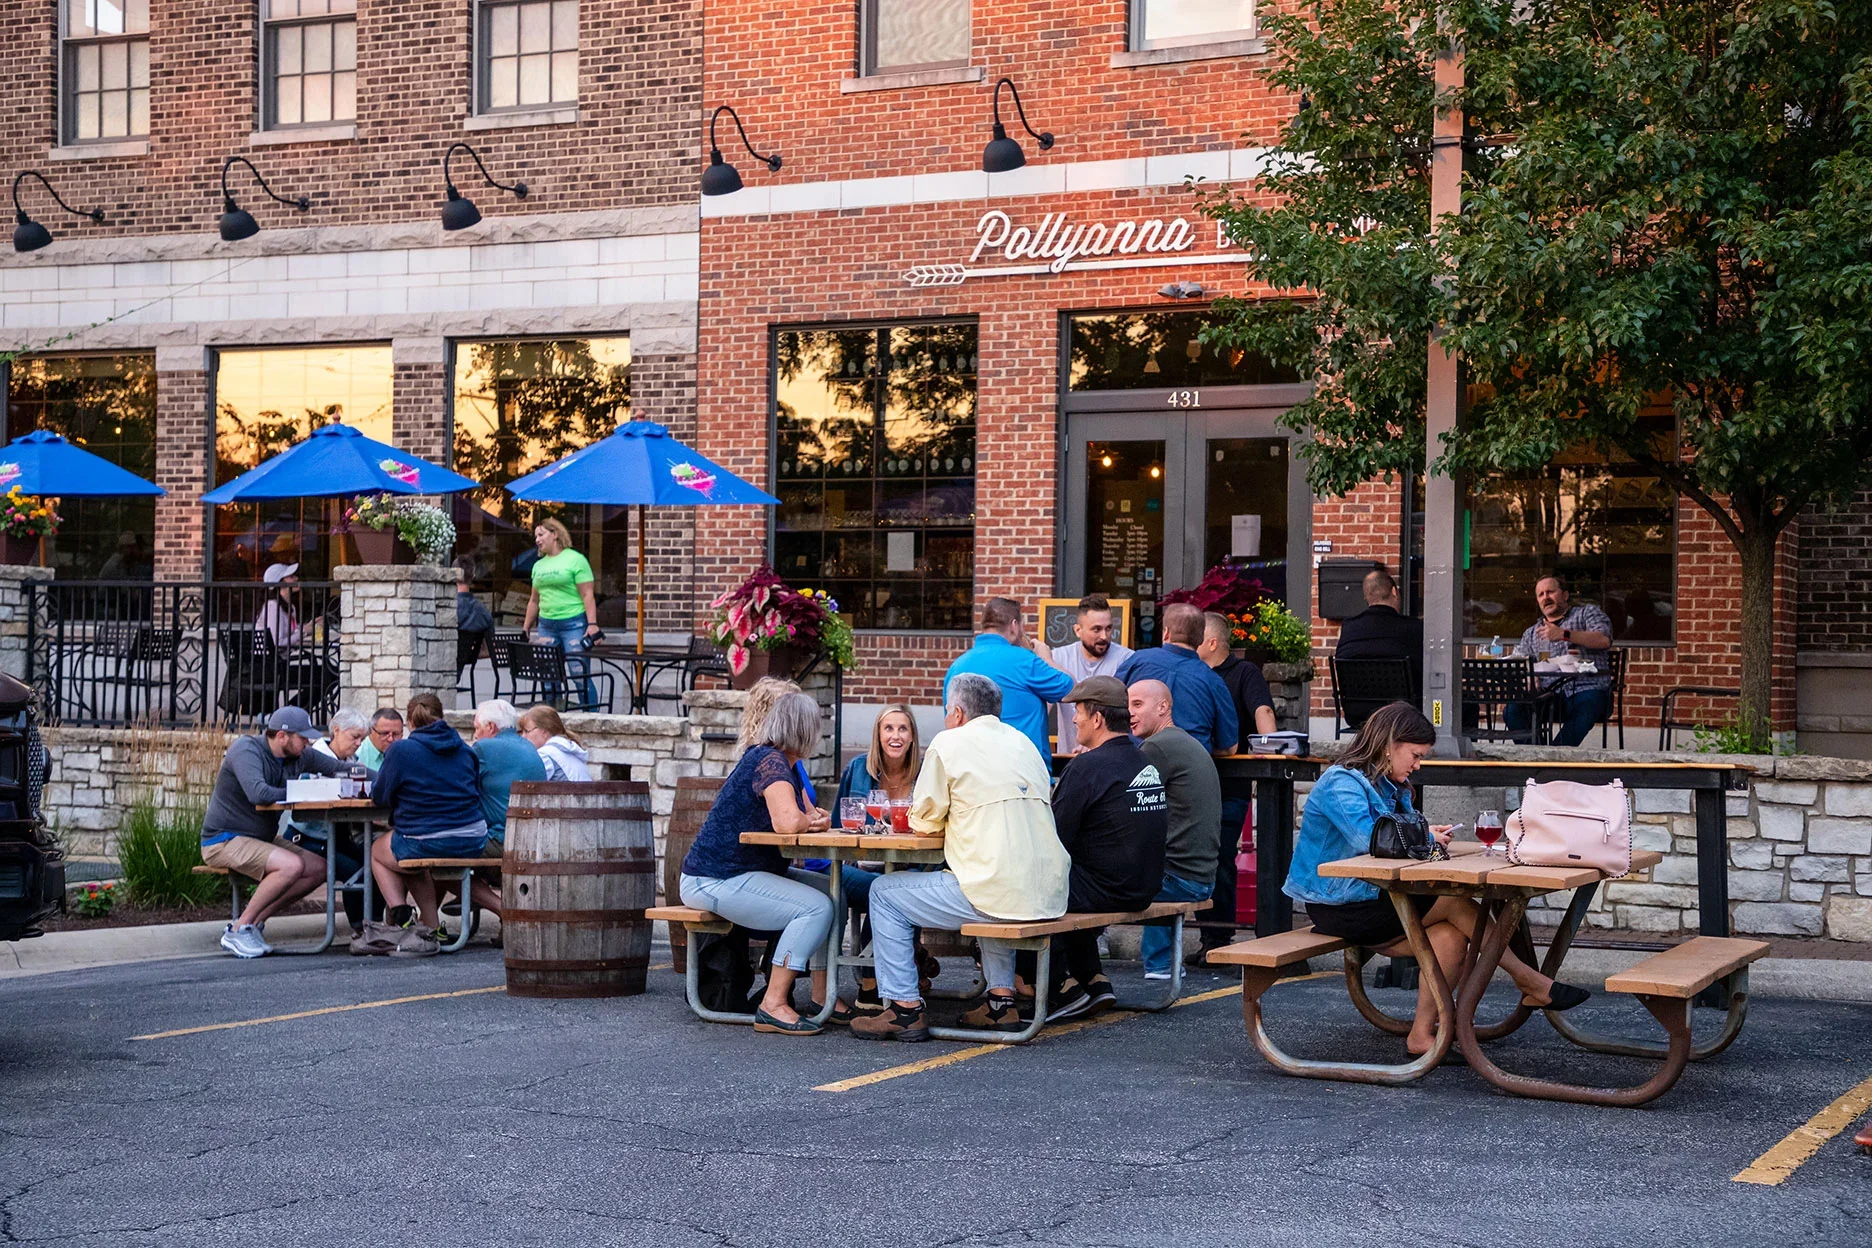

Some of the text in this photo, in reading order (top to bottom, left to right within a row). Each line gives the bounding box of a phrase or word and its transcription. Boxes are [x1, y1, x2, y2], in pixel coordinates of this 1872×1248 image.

[968, 210, 1196, 274] Pollyanna
[1167, 390, 1200, 408] 431
[1136, 791, 1158, 805] Route
